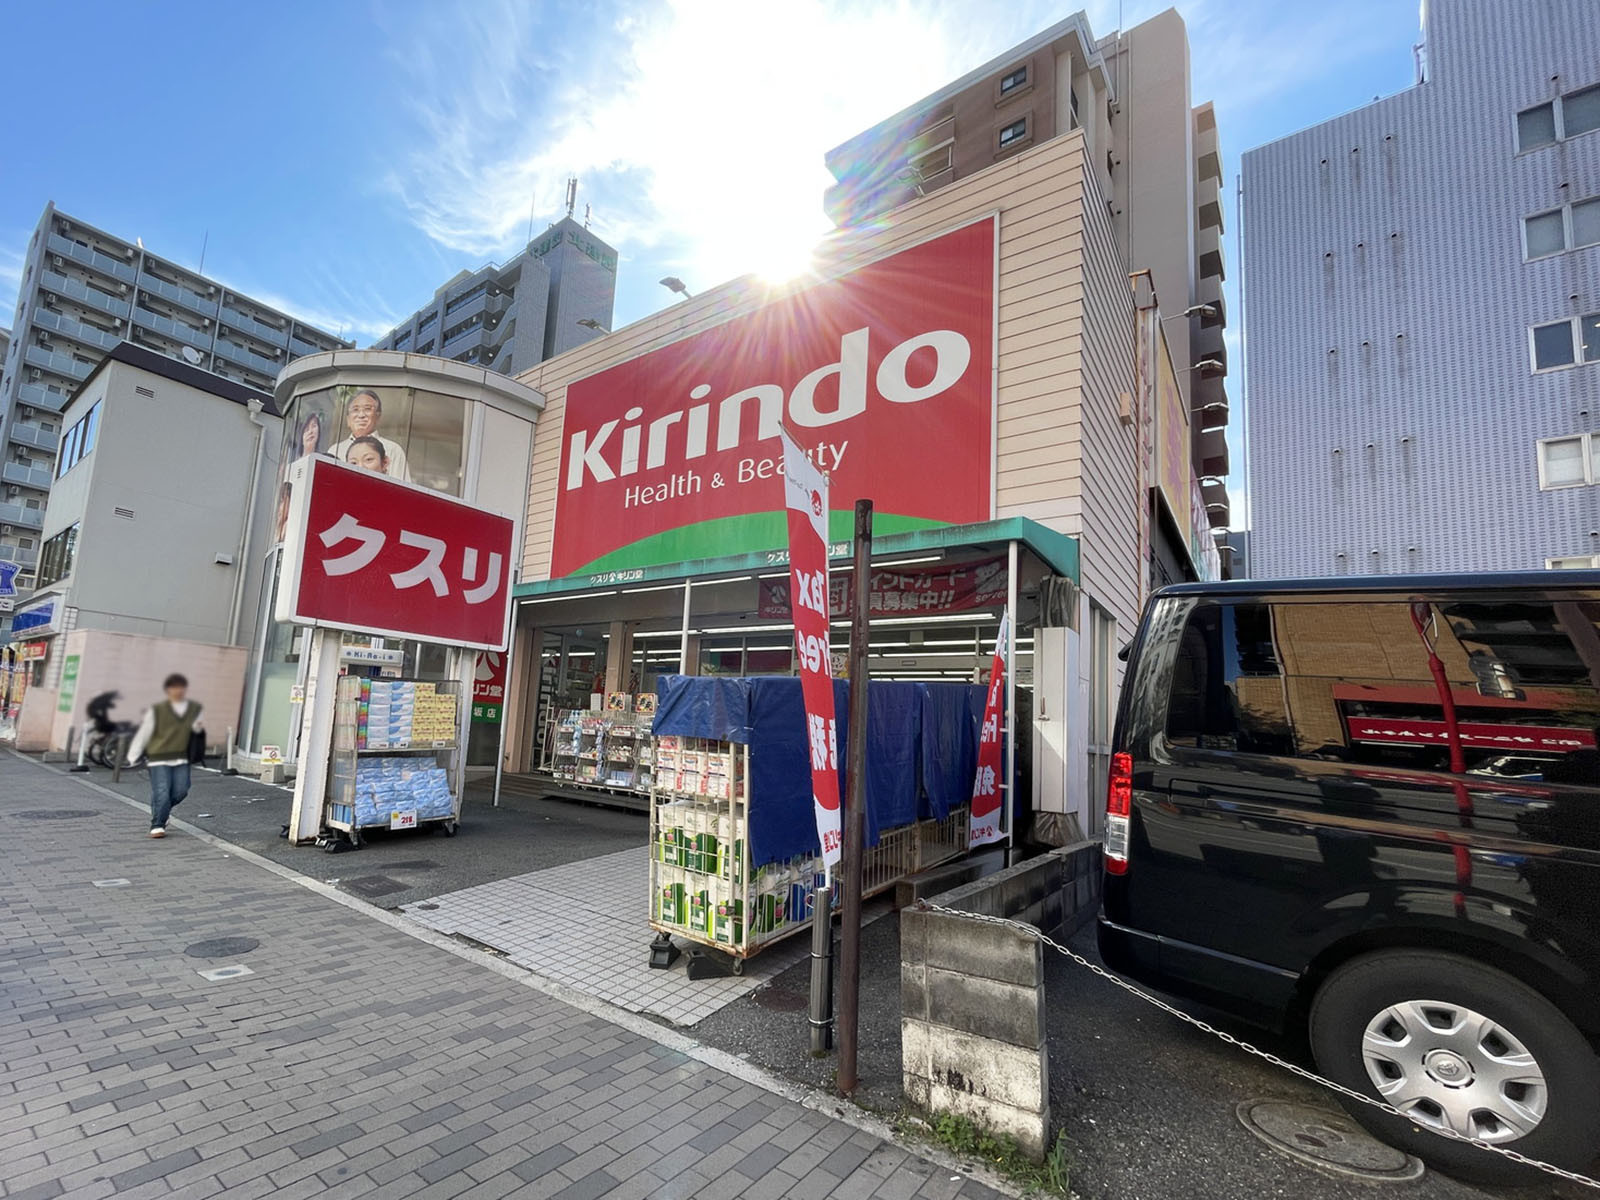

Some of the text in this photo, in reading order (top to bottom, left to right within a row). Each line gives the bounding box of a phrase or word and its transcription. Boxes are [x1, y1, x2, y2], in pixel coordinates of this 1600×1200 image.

[566, 327, 971, 490] Kirindo
[624, 440, 849, 509] Health & Beaty
[319, 513, 502, 605] クスリ
[870, 568, 968, 590] イントカード
[869, 590, 955, 611] 員募集中!!
[473, 684, 502, 697] リン堂
[473, 706, 496, 718] 坂店
